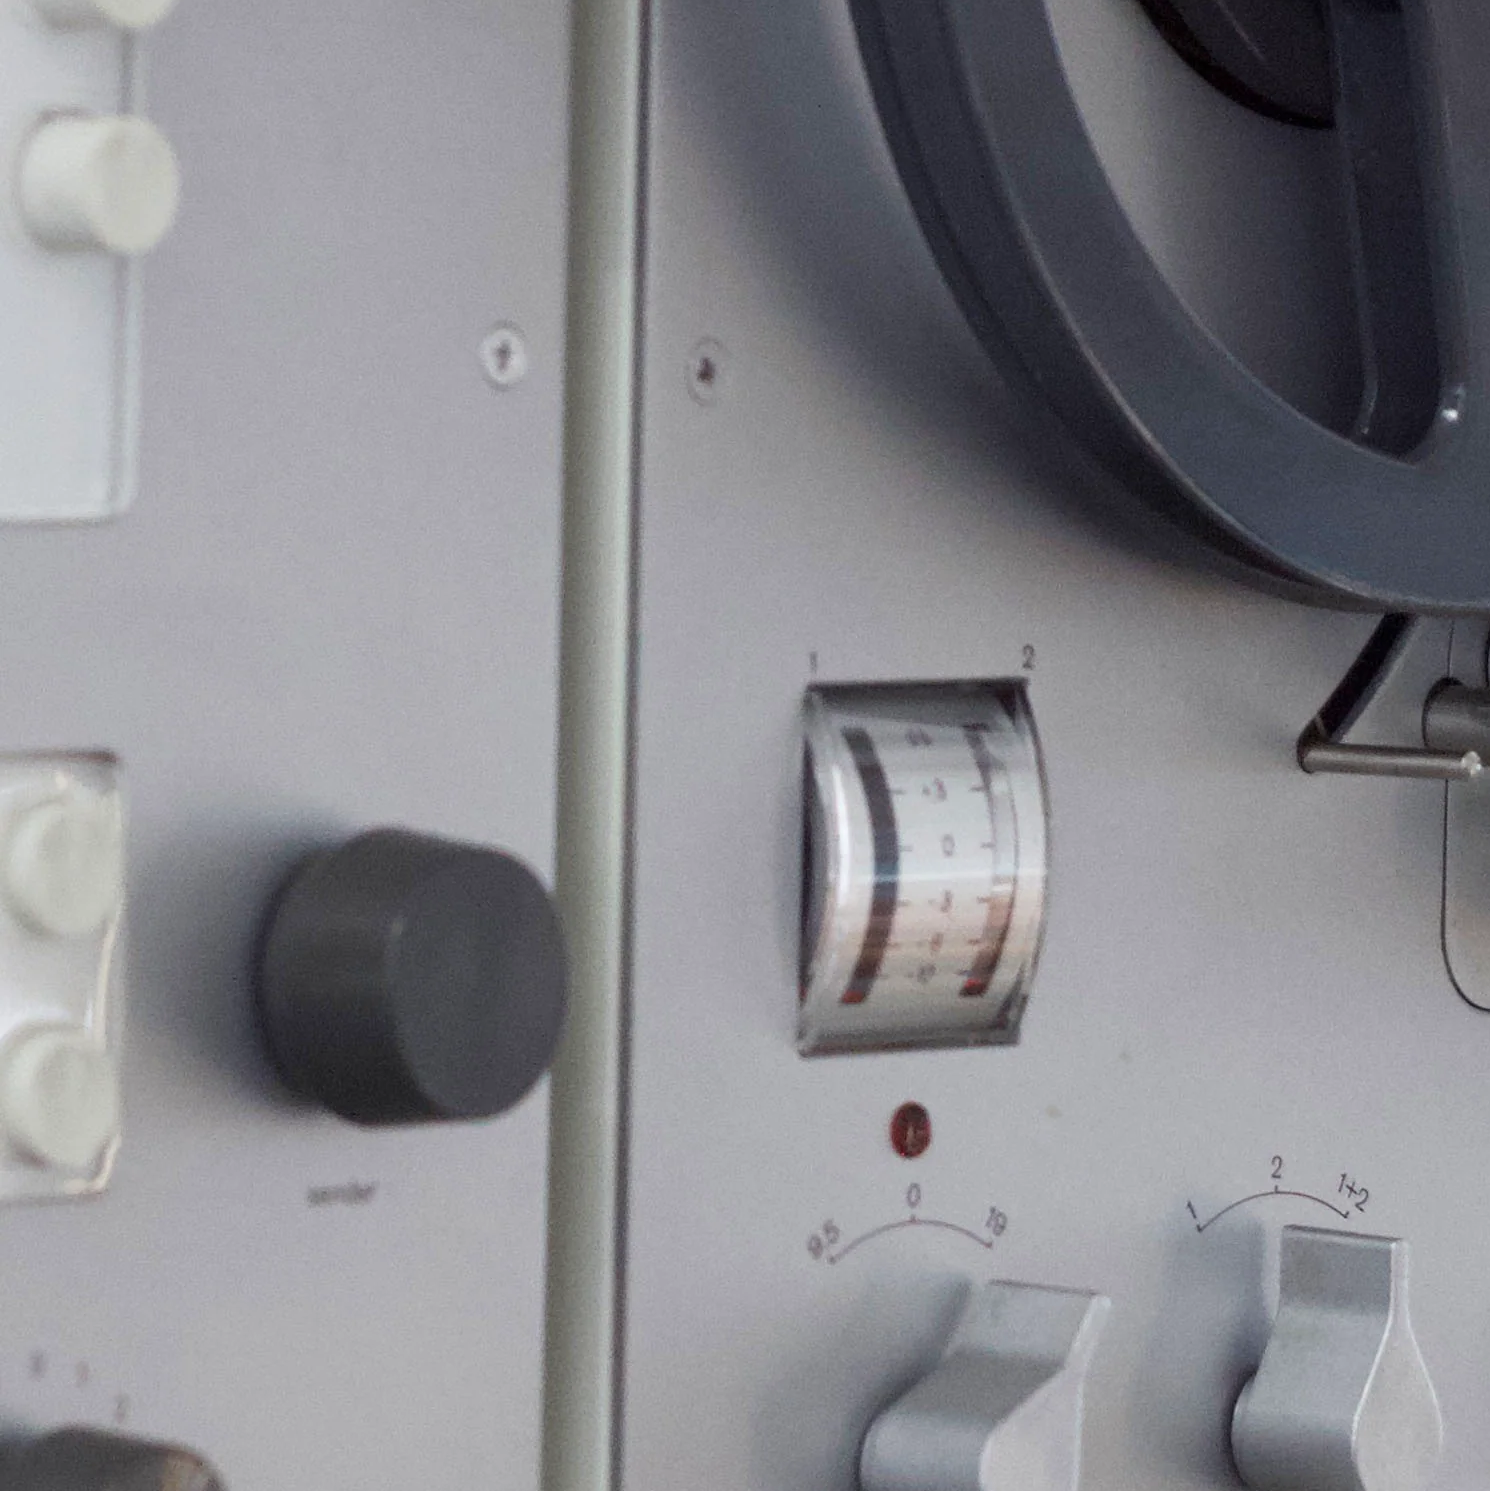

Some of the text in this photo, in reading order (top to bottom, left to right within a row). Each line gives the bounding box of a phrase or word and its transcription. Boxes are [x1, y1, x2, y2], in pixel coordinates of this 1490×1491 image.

[1022, 644, 1034, 670] 2
[1271, 1155, 1283, 1178] 2
[1338, 1173, 1370, 1213] 1+2
[1187, 1200, 1197, 1219] 1
